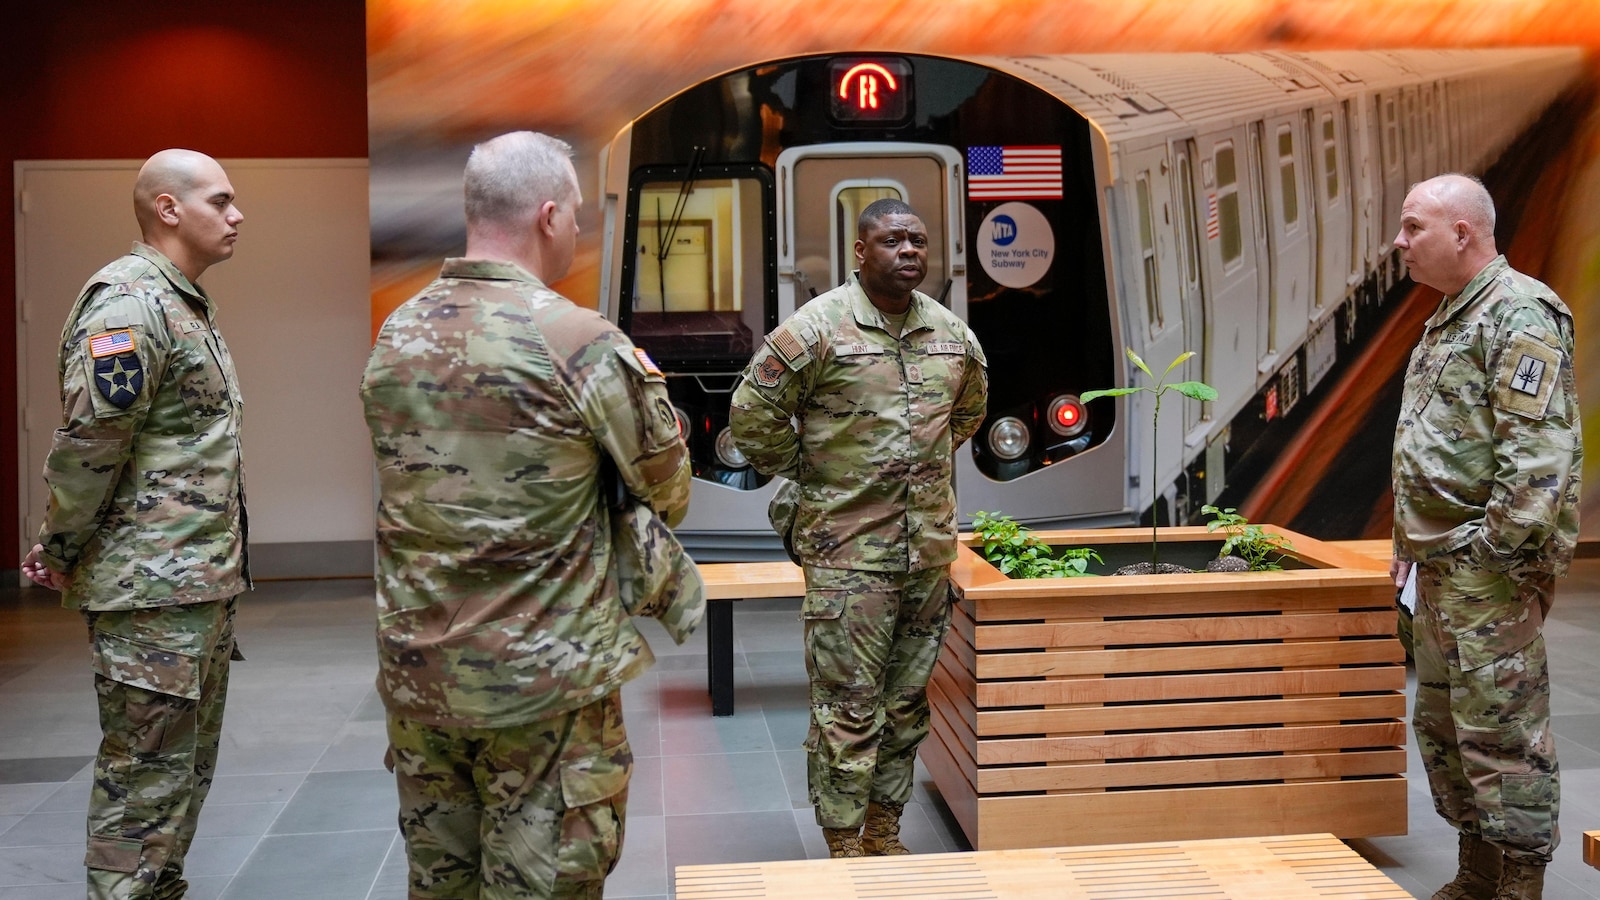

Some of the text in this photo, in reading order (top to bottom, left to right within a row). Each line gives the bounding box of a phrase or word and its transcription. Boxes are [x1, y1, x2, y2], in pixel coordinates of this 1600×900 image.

[859, 74, 878, 109] R
[990, 220, 1014, 241] MTA
[990, 248, 1048, 259] New York City
[991, 259, 1026, 269] Subway
[851, 344, 869, 354] HUNT
